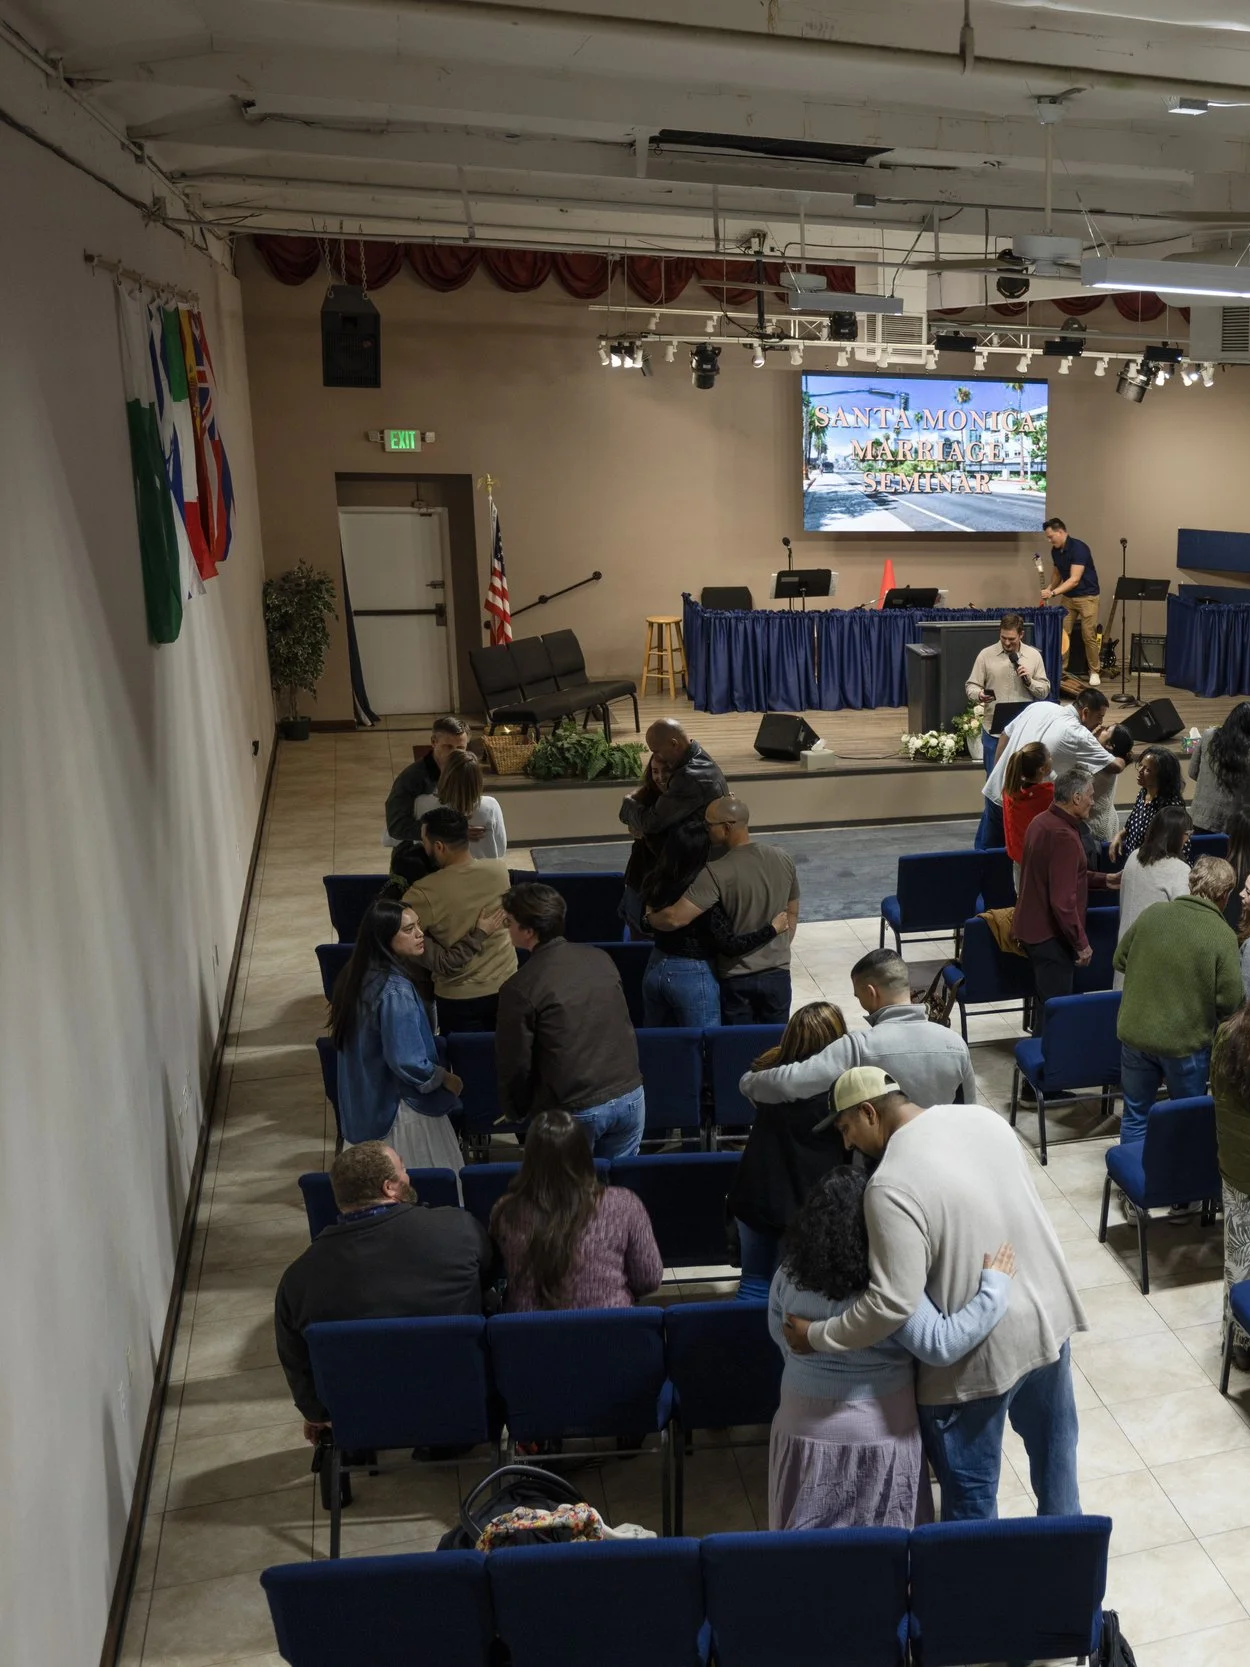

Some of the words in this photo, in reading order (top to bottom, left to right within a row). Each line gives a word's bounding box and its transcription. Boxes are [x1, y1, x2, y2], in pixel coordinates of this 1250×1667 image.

[814, 405, 912, 430] SANTA
[922, 408, 1036, 432] MONICA
[391, 431, 416, 449] EXIT
[850, 439, 1005, 463] MARRIAGE
[863, 471, 993, 494] SEMINAR
